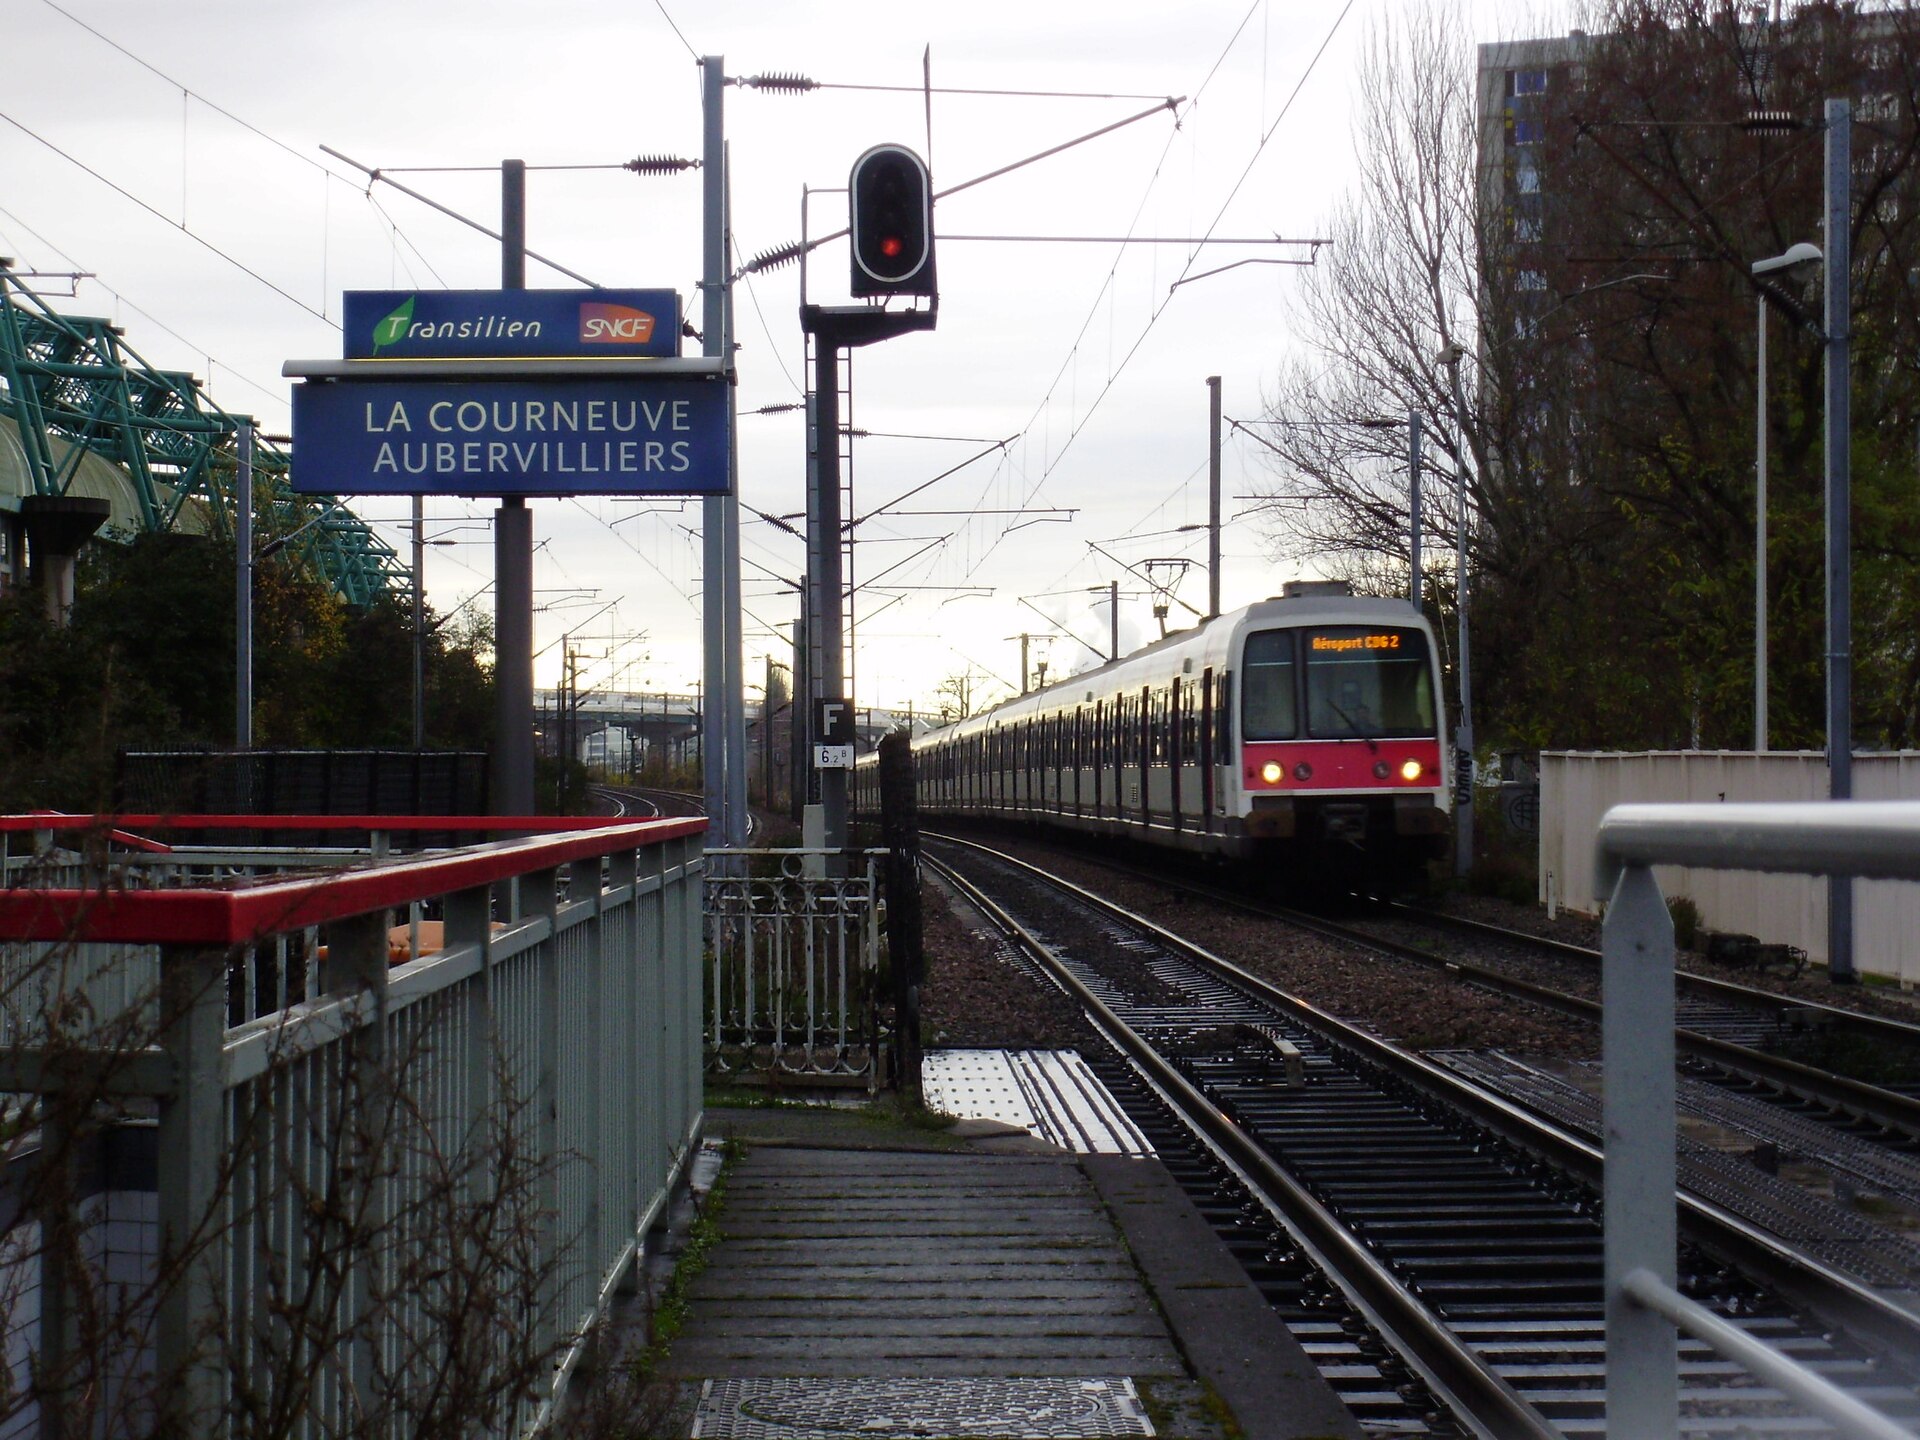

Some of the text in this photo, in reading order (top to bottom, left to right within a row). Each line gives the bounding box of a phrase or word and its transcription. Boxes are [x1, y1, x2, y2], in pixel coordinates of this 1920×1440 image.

[388, 316, 541, 339] Transilien
[583, 317, 651, 338] SNCF
[366, 400, 691, 433] LA COURNEUVE
[373, 441, 691, 474] AUBERVILLIERS
[1390, 634, 1399, 648] 2
[823, 703, 844, 736] F
